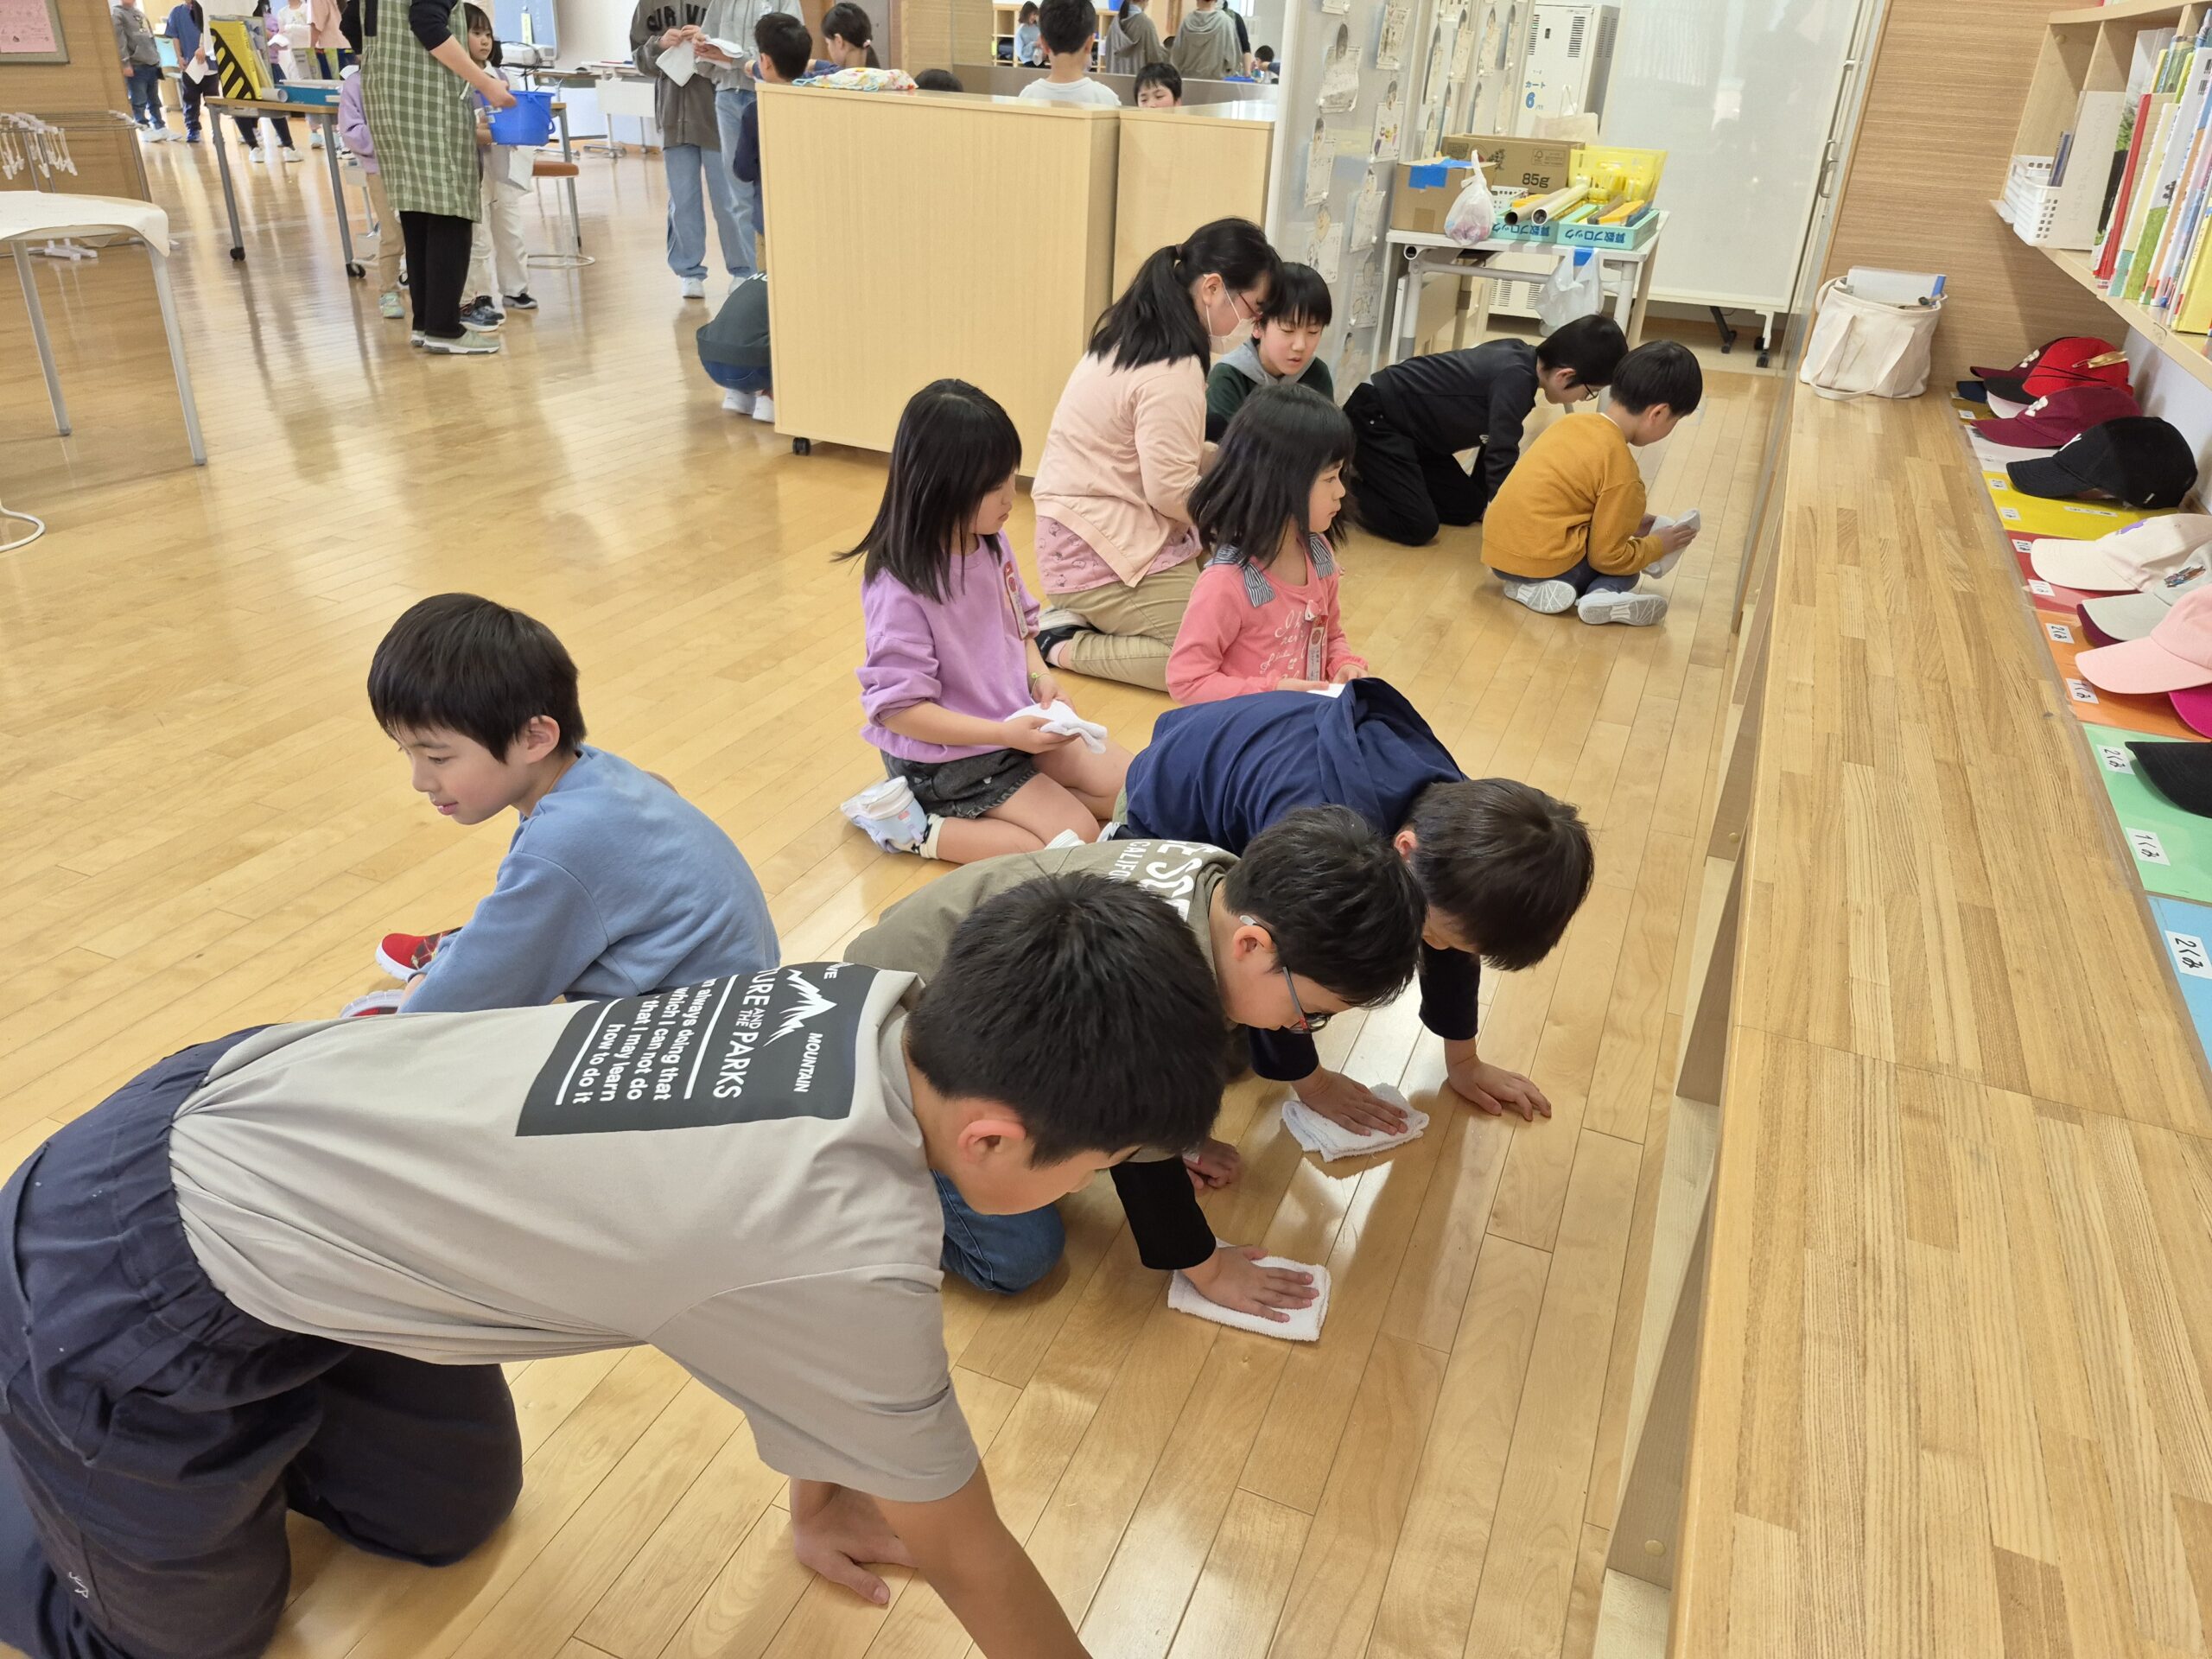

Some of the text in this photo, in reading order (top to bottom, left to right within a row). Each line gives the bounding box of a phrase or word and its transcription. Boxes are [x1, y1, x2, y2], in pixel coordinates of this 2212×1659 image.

[1522, 173, 1550, 188] 85g
[1492, 223, 1550, 237] 算数ブロック
[1565, 229, 1626, 244] 算数ブロック
[2051, 626, 2068, 639] 2くみ
[2073, 682, 2091, 698] 1くみ
[2104, 748, 2126, 768] 2くみ
[2135, 835, 2160, 857] 1くみ
[2175, 938, 2204, 969] 2くみ
[634, 1000, 659, 1025] that
[661, 987, 690, 1018] which
[683, 988, 712, 1027] always
[749, 1007, 766, 1029] AND
[613, 1033, 642, 1059] may
[647, 1028, 669, 1050] can
[661, 1029, 695, 1064] doing
[572, 1024, 626, 1103] how to do it
[634, 1052, 657, 1074] not
[713, 1010, 760, 1098] THE PARKS
[793, 1033, 823, 1093] MOUNTAIN
[600, 1061, 631, 1102] learn
[626, 1077, 648, 1100] do
[653, 1067, 679, 1101] that
